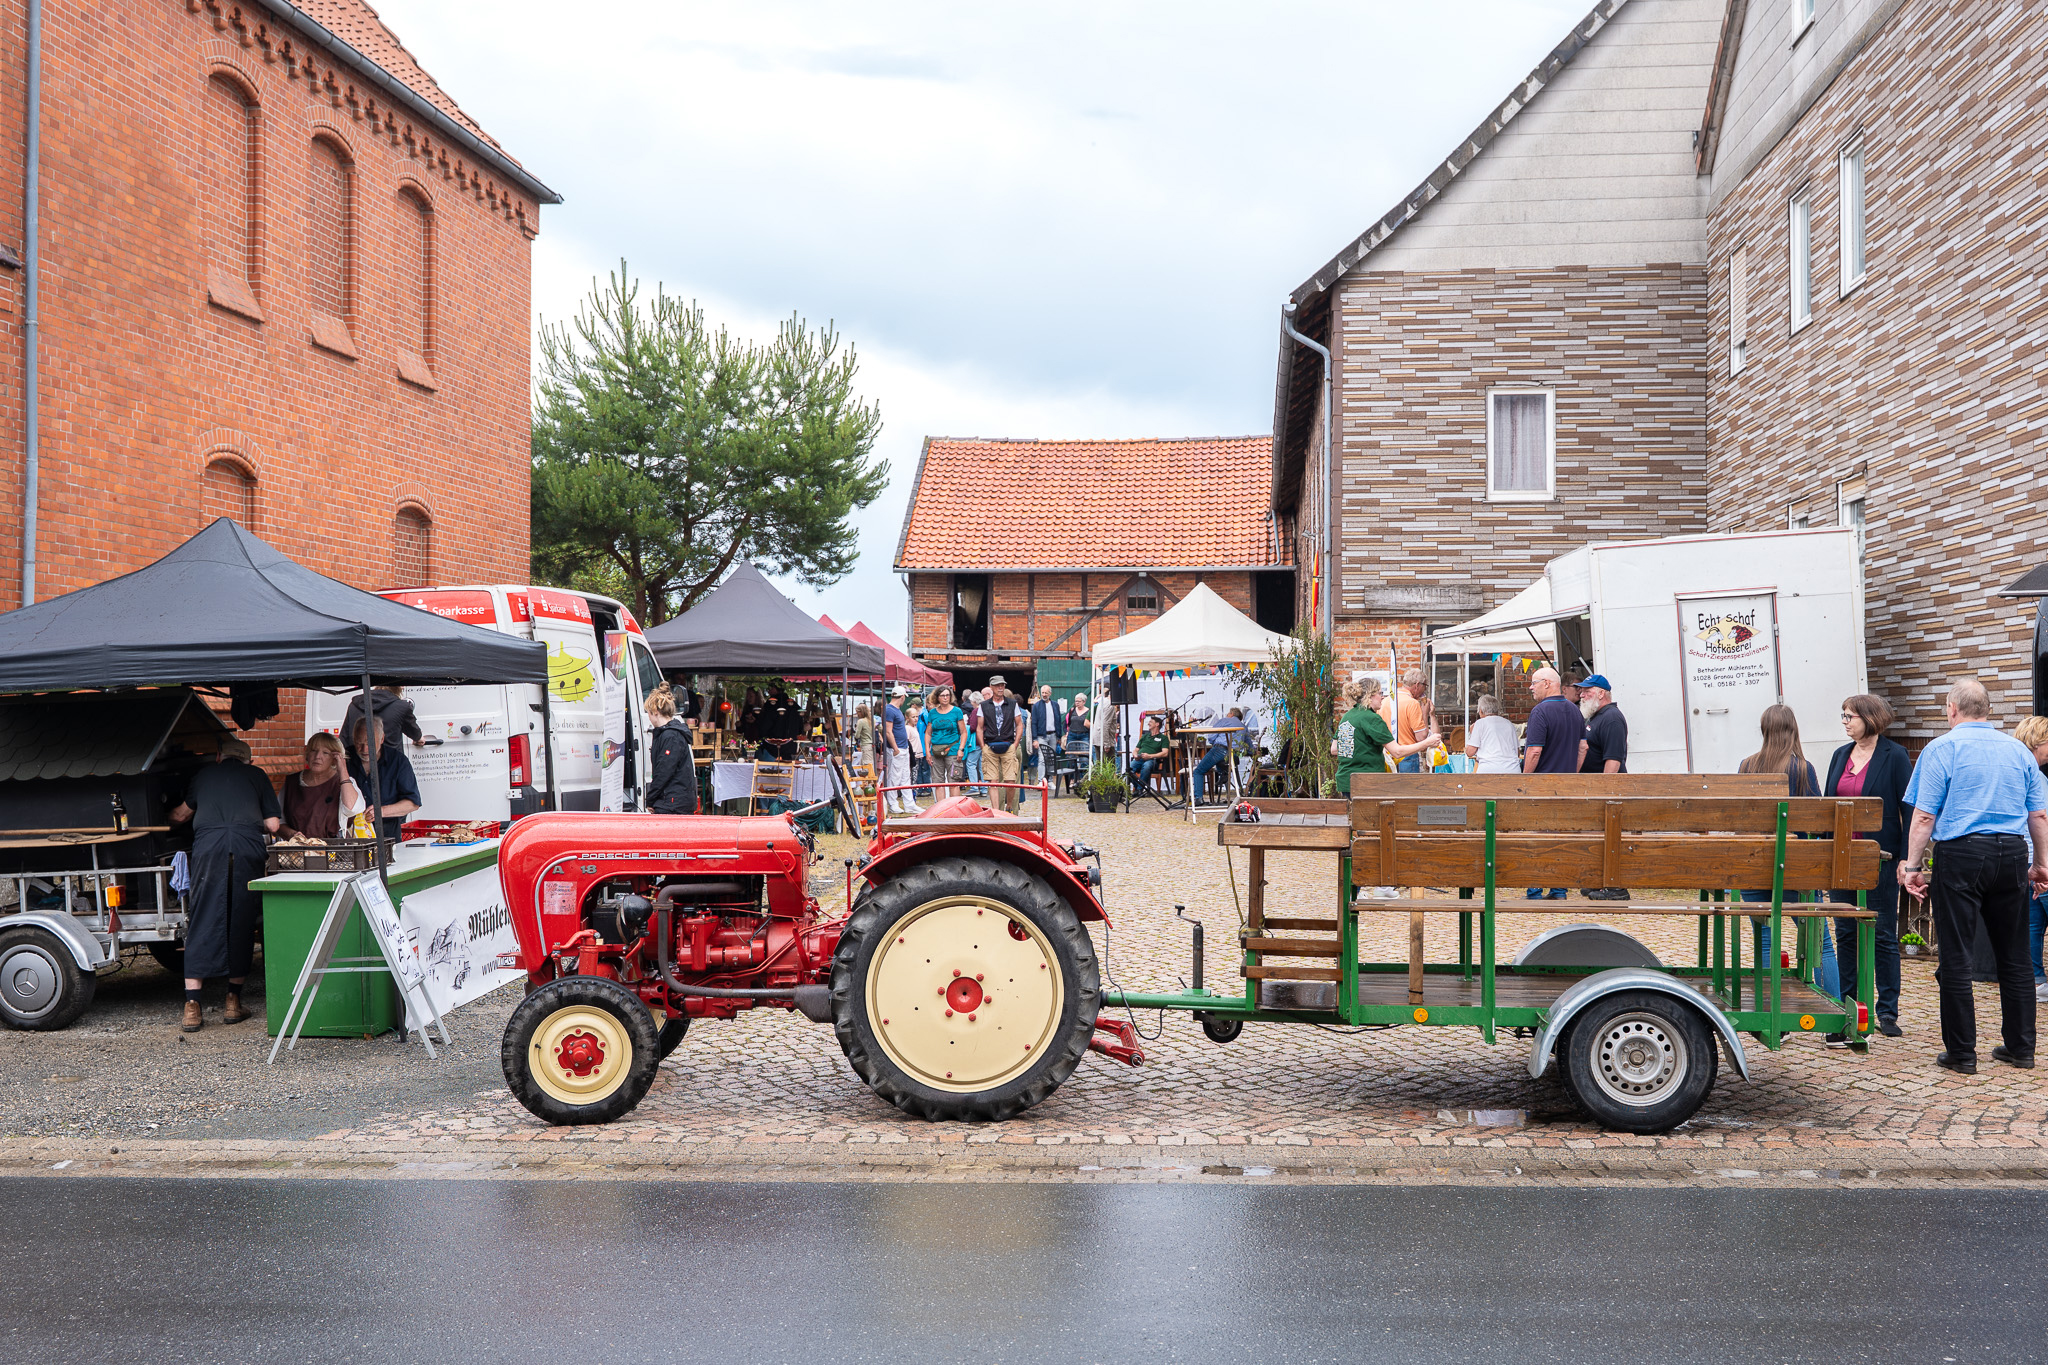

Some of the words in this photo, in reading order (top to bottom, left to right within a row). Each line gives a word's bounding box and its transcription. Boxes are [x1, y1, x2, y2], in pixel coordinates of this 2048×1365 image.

[432, 605, 486, 616] Sparkasse
[1698, 613, 1720, 630] Echt
[1726, 609, 1755, 626] Schaf
[1705, 639, 1752, 654] Hofkäserei
[412, 752, 448, 760] MusikMobil
[552, 865, 565, 875] A
